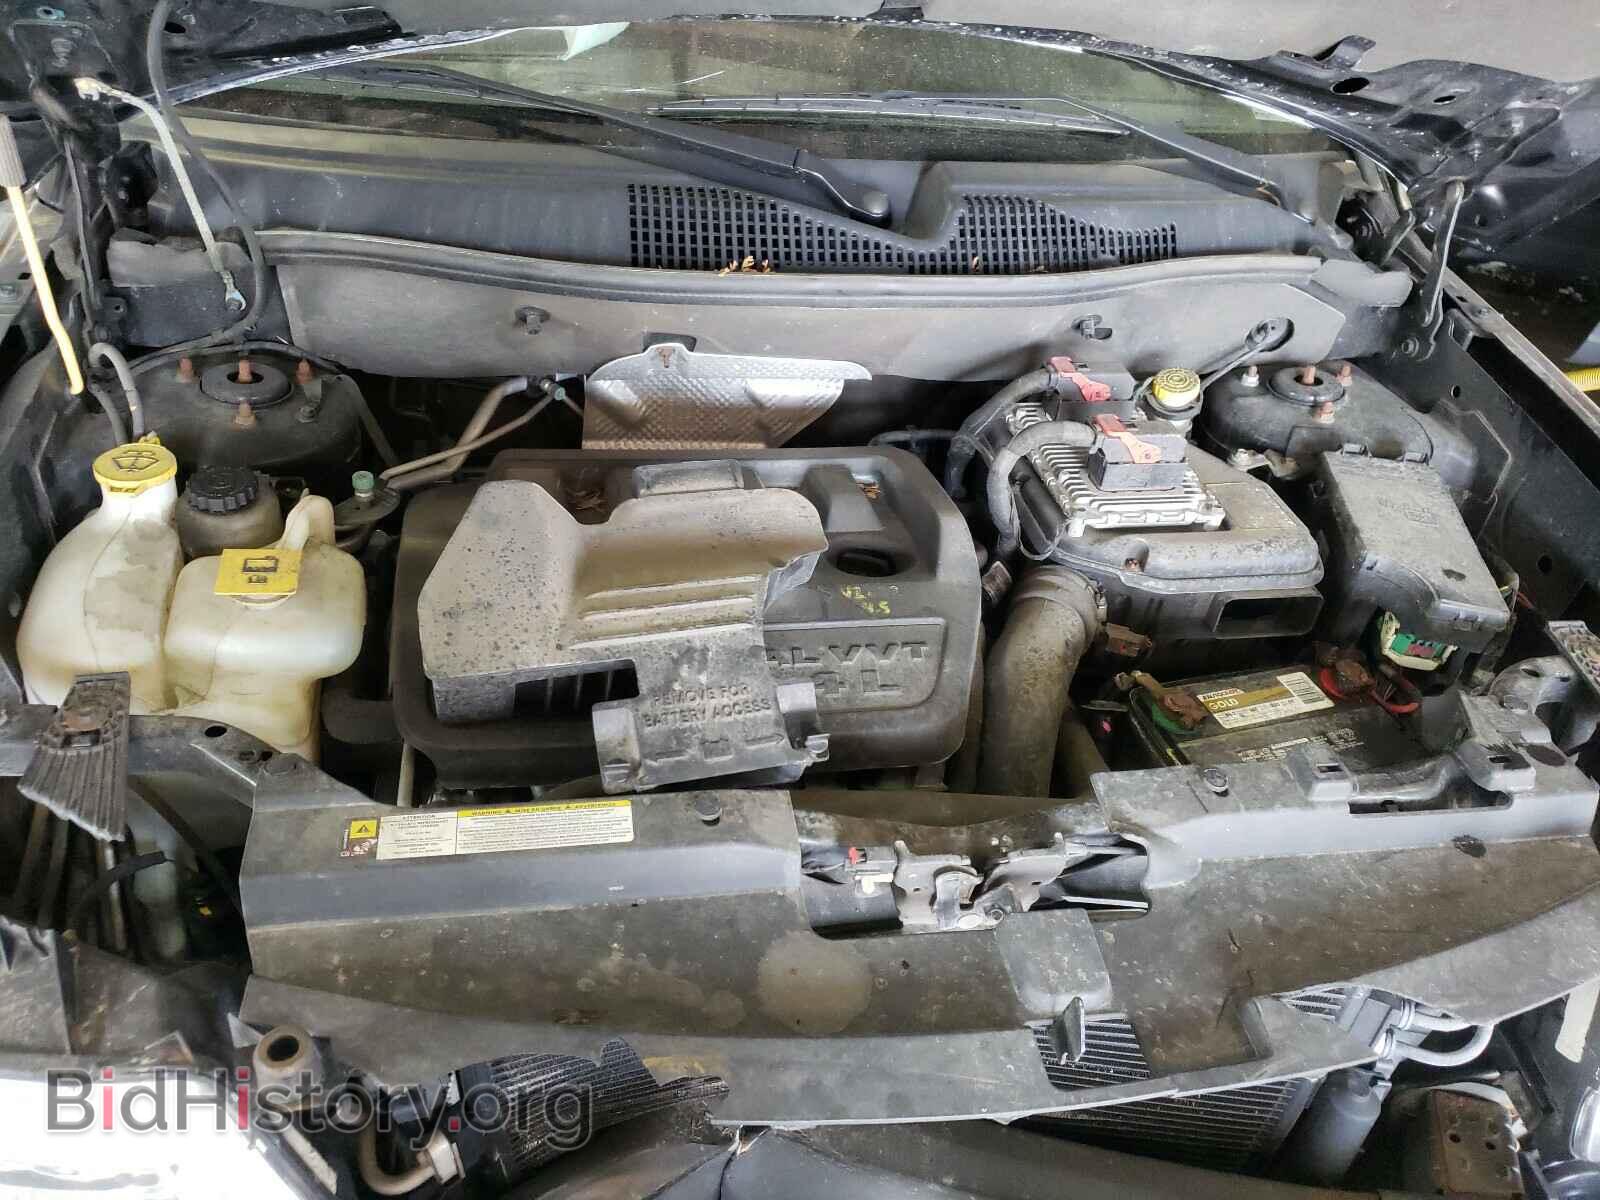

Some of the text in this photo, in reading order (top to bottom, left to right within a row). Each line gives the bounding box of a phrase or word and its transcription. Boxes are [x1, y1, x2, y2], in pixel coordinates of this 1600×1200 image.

[765, 640, 929, 667] AL VVT
[654, 683, 752, 705] REMOVE FOR
[1208, 698, 1240, 711] GOLD
[642, 698, 772, 727] BATTERY ACCESS
